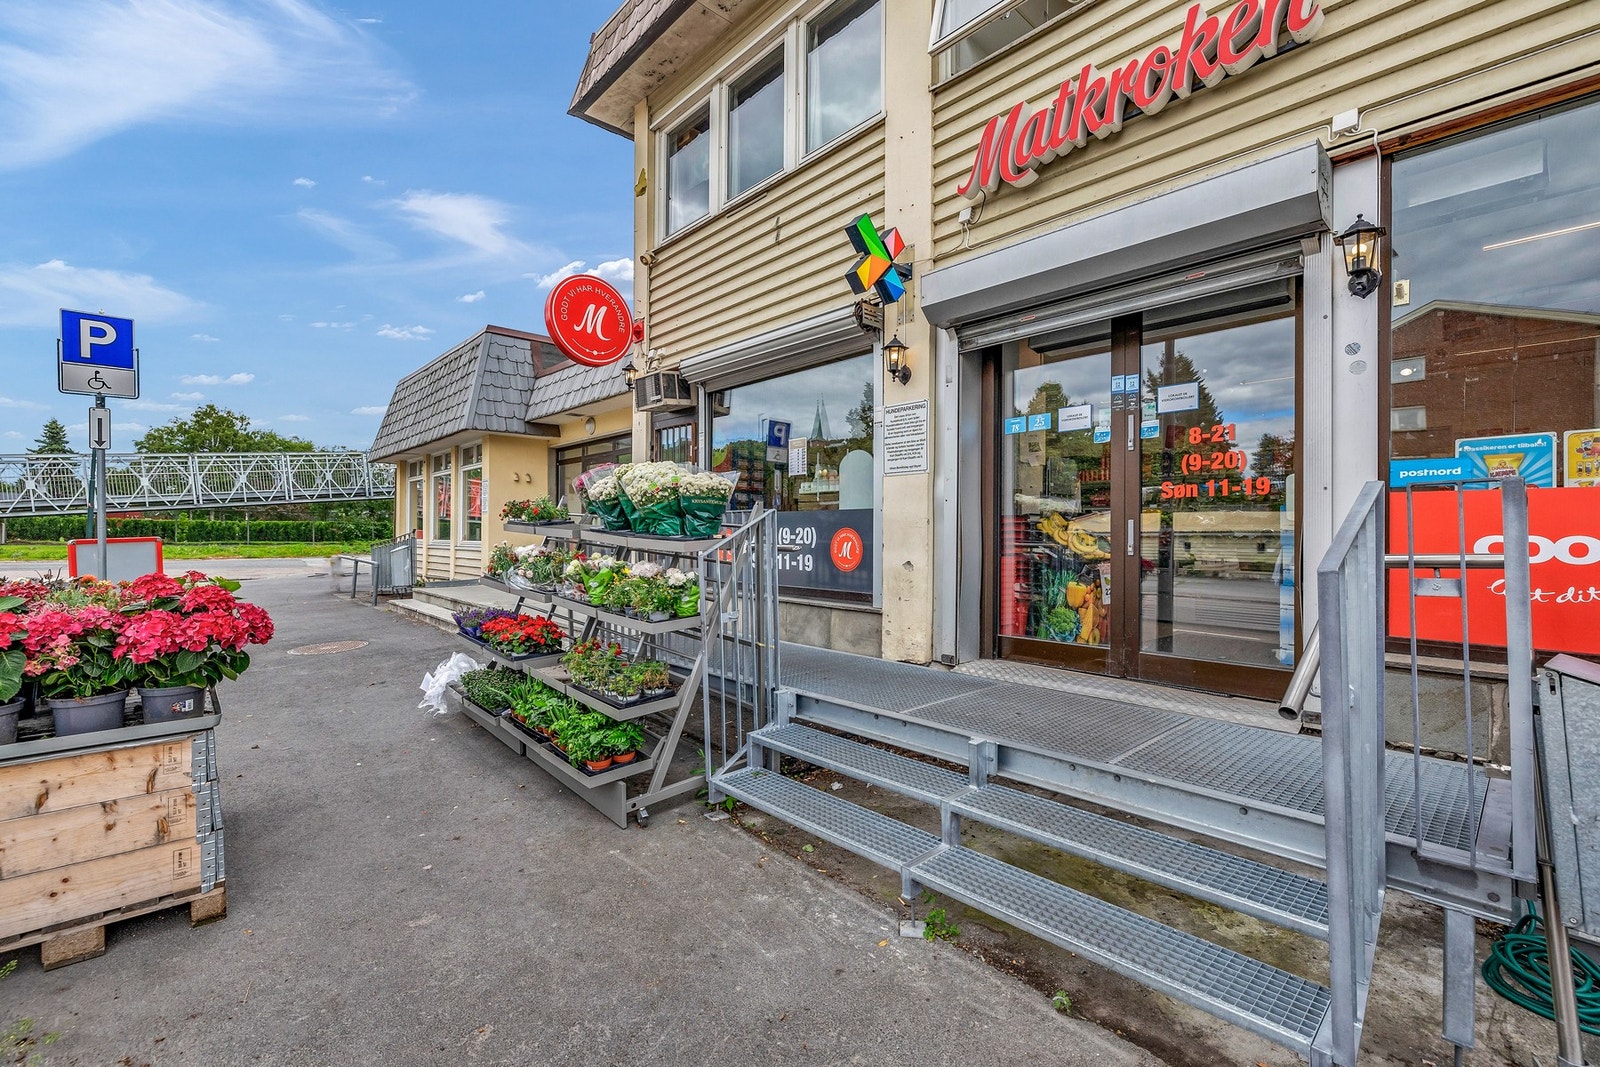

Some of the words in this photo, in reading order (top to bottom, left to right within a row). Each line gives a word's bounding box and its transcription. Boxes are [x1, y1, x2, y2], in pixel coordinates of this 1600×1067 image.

[957, 0, 1320, 196] Matkroken
[560, 296, 571, 321] GODT
[567, 289, 577, 297] VI
[576, 284, 593, 293] HAR
[595, 287, 626, 334] HVERANDRE
[573, 303, 612, 341] M
[80, 318, 117, 359] P
[885, 403, 926, 414] HUNDEPARKERING
[1188, 423, 1236, 445] 8-21
[1181, 450, 1248, 475] (9-20)
[1399, 466, 1462, 479] postnord
[1161, 481, 1199, 499] Søn
[1206, 476, 1271, 497] 11-19
[778, 527, 817, 549] (9-20)
